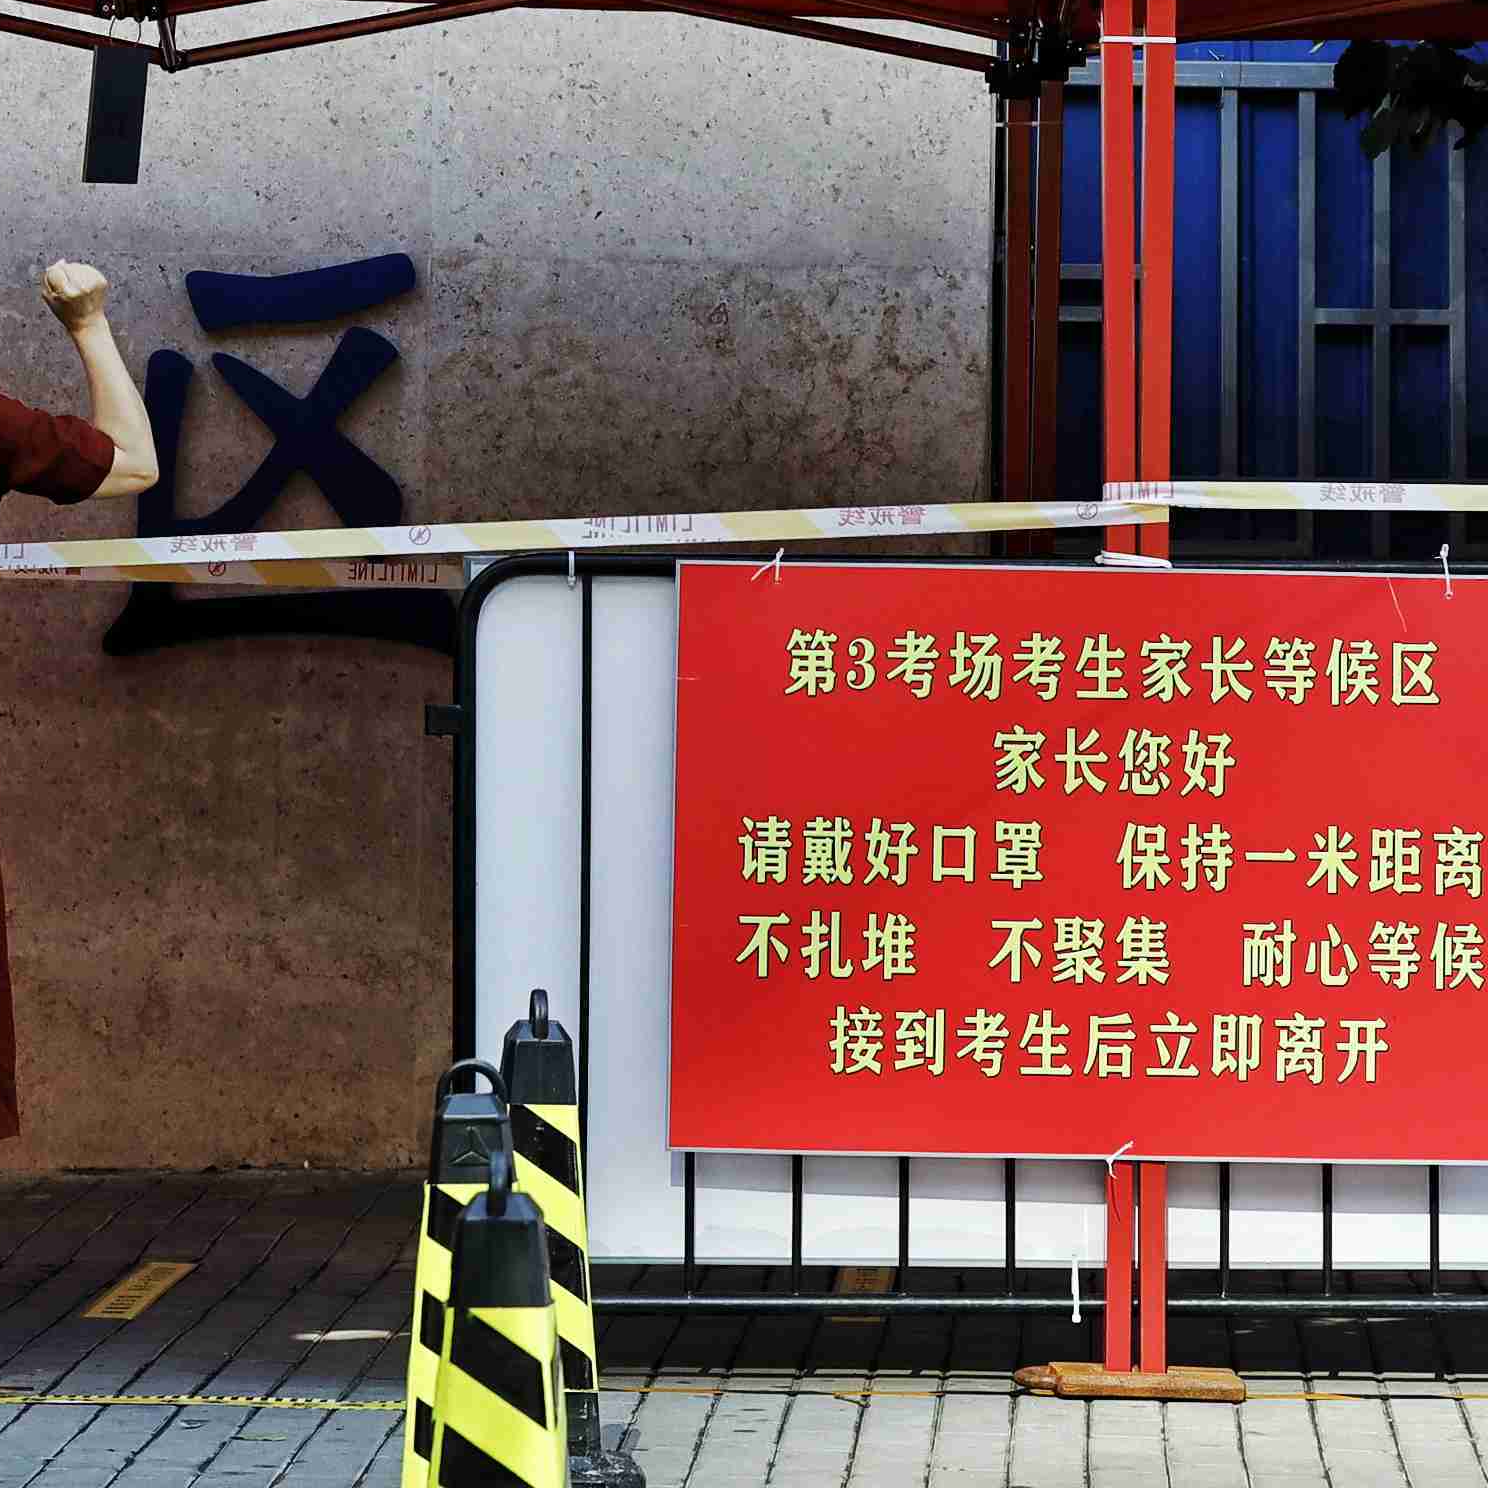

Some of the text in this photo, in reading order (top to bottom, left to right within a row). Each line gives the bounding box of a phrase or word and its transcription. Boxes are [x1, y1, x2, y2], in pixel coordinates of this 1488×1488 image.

[783, 627, 1442, 707] 第3考场考生家长等候区
[992, 723, 1237, 798] 家长您好
[736, 814, 1486, 899] 请戴好口罩 保持一米距离
[734, 909, 1487, 991] 不扎堆 不聚集 耐心等候
[827, 1004, 1391, 1087] 接到考生后立即离开
